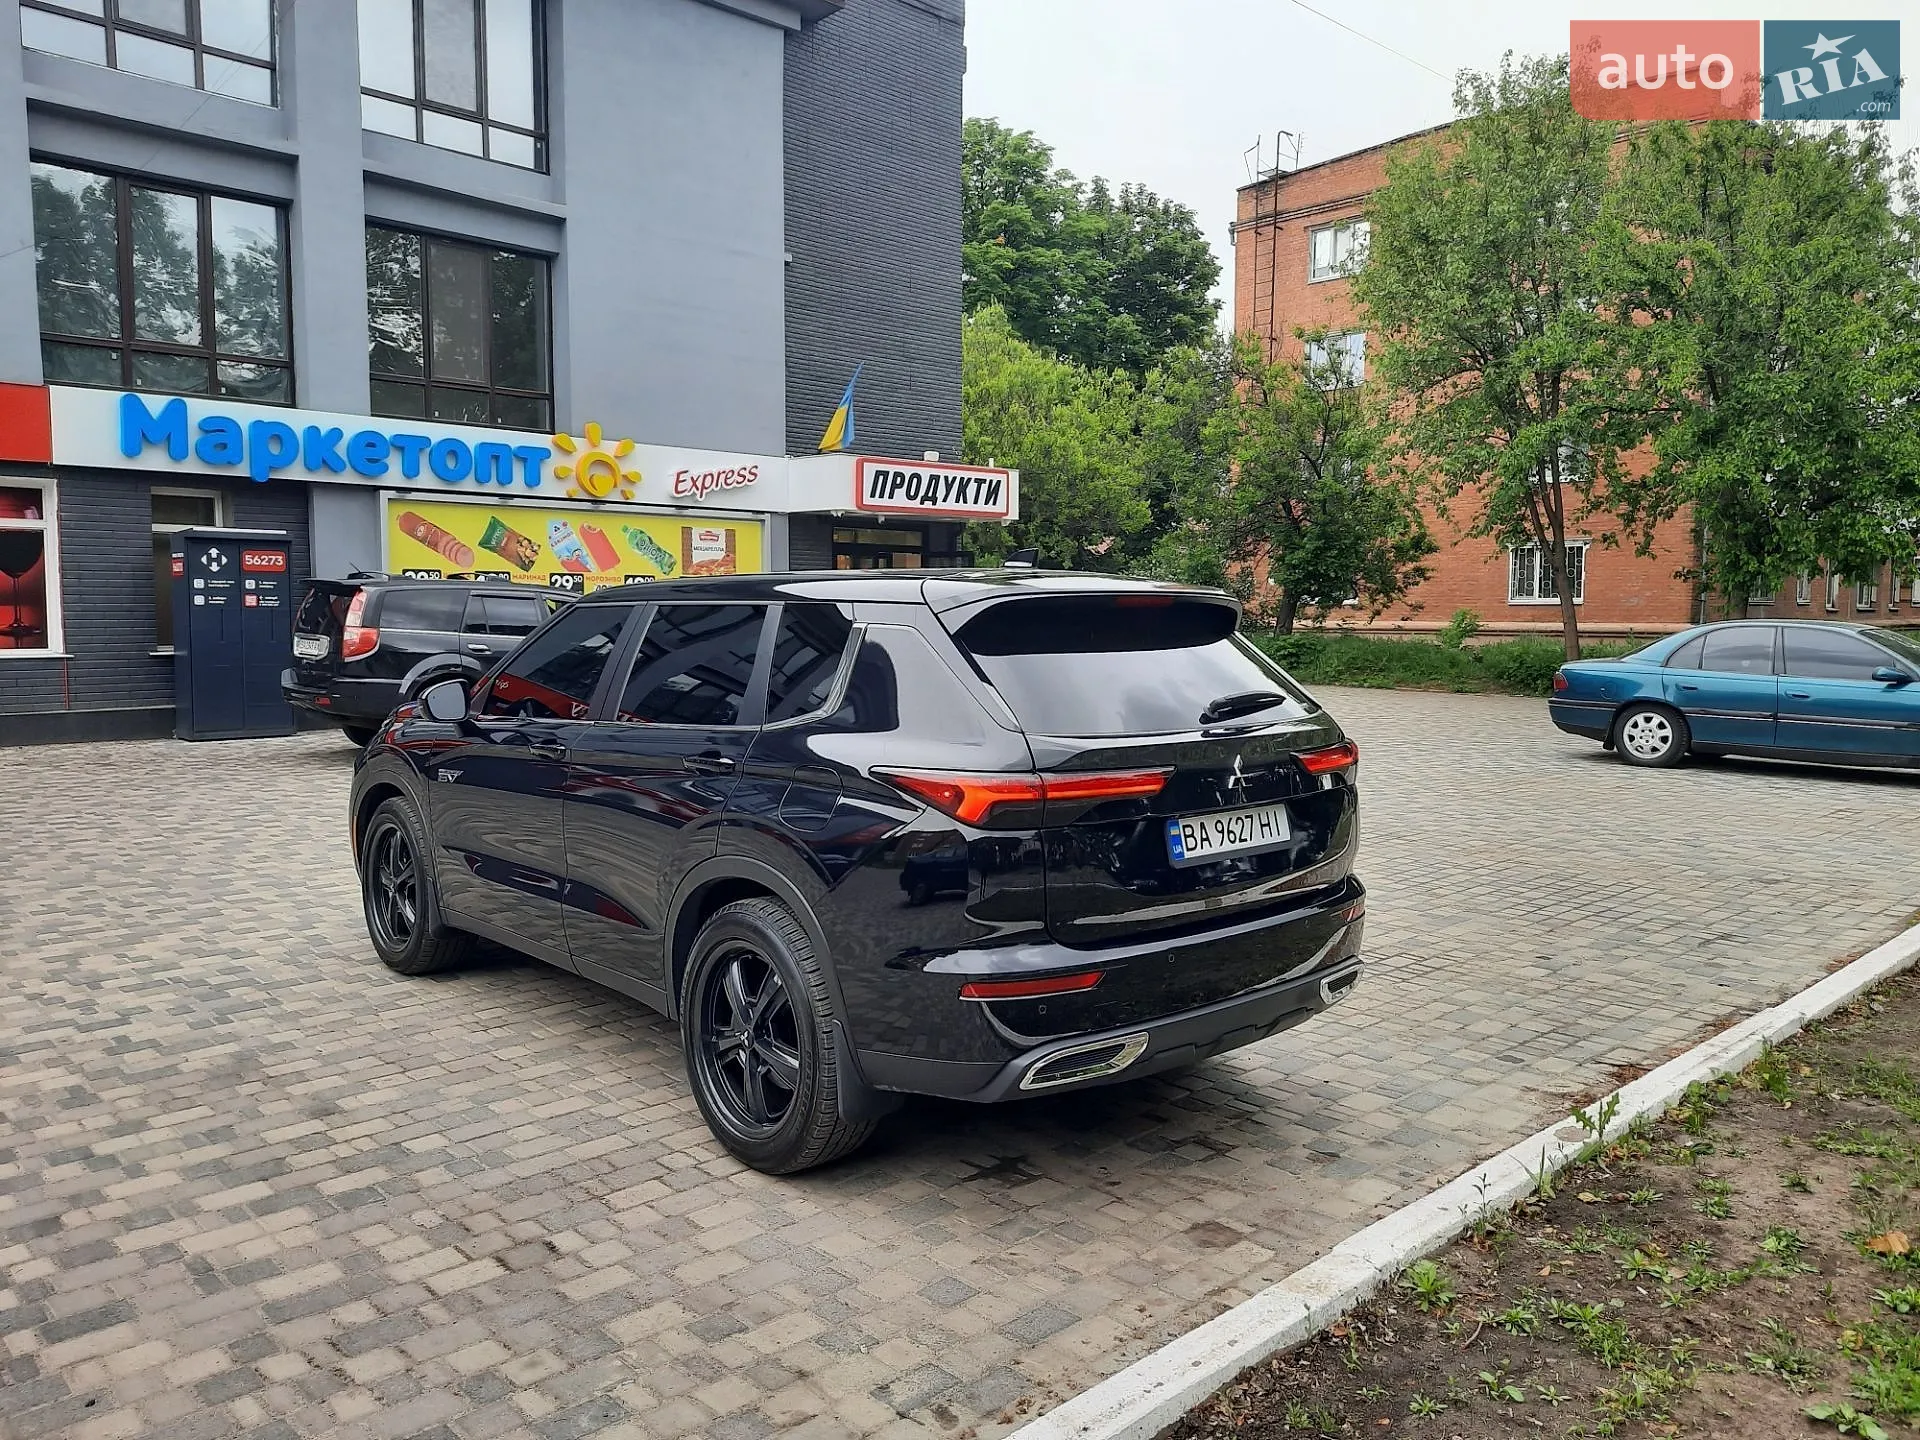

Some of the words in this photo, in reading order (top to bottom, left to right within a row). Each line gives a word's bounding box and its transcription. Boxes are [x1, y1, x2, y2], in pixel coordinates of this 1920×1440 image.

[120, 393, 551, 487] Маркетопт
[674, 464, 759, 497] Express
[869, 469, 1002, 507] ПРОДУКТИ
[244, 554, 284, 567] 56273
[1182, 822, 1212, 852] BA
[1215, 814, 1254, 848] 9627
[1258, 810, 1281, 839] HI
[1173, 846, 1182, 854] UA
